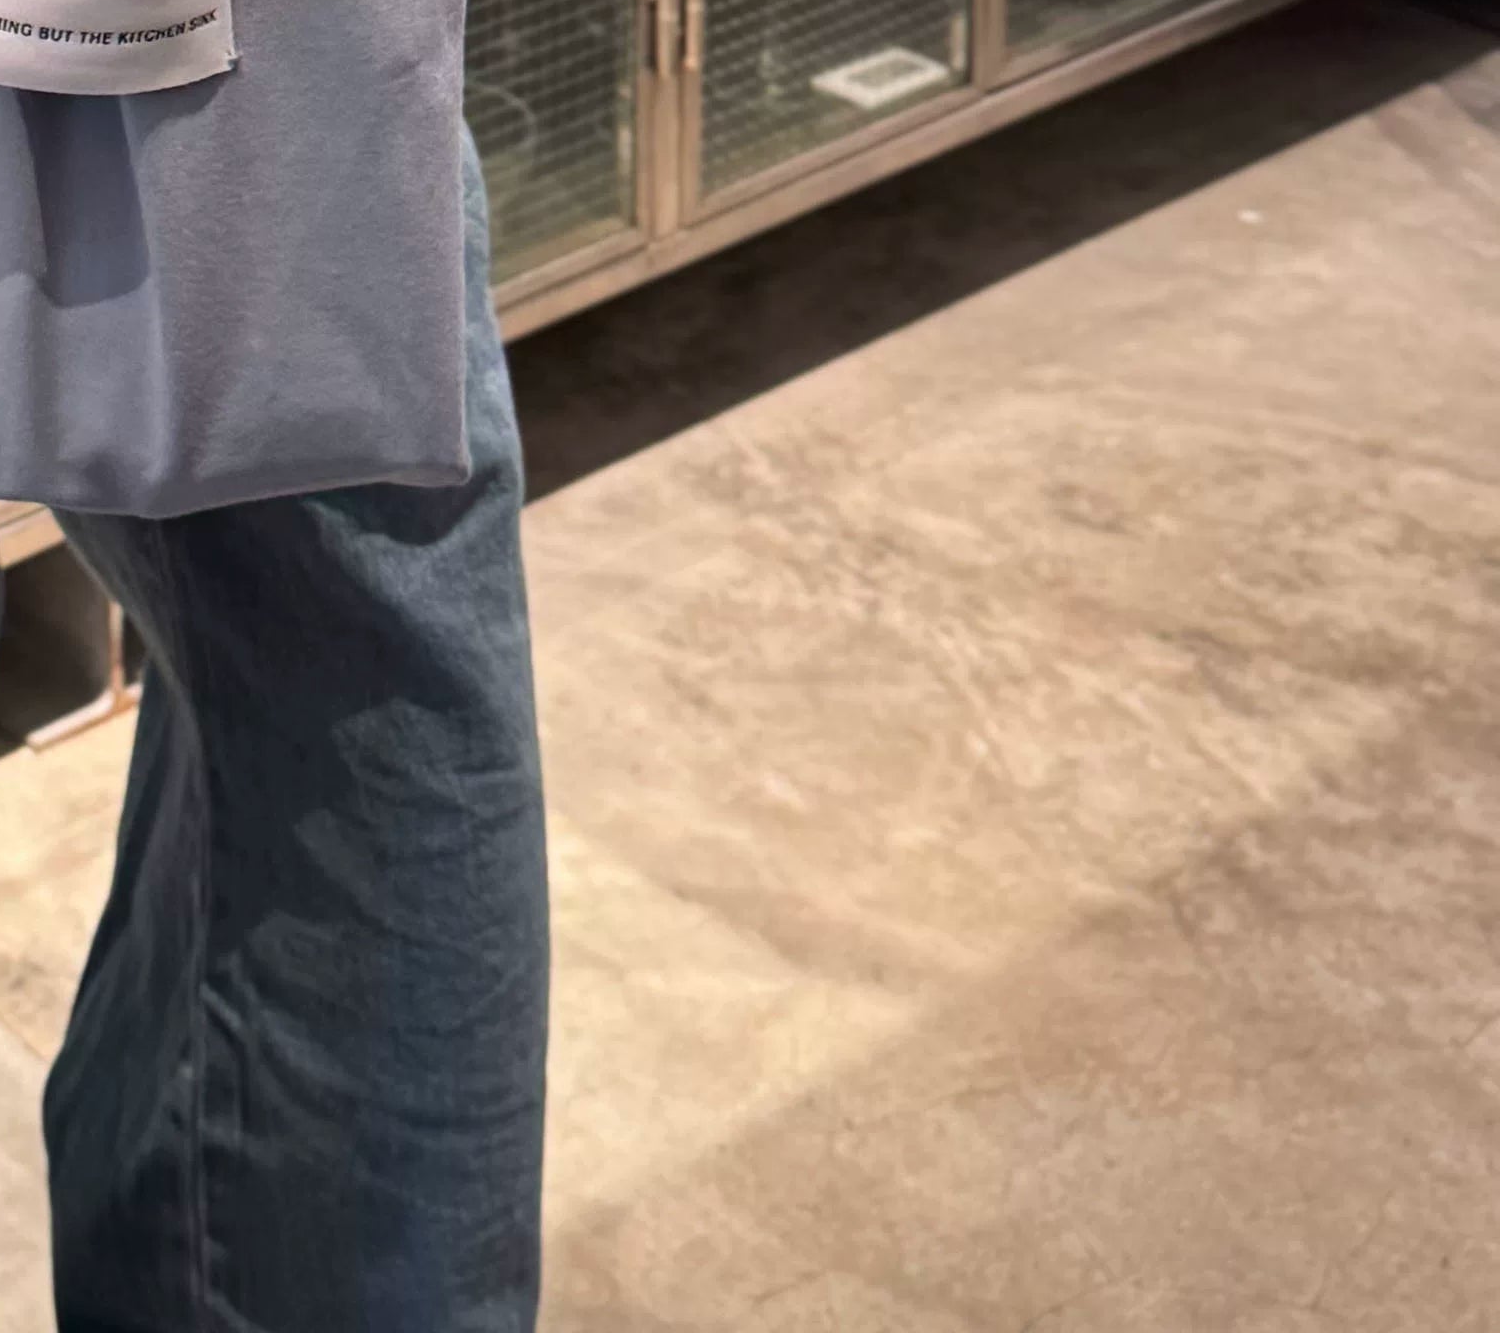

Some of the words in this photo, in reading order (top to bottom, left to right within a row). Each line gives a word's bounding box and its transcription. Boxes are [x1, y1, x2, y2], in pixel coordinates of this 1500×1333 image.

[38, 26, 73, 43] BUT
[80, 31, 113, 46] THE
[117, 21, 186, 45] KITCHEN
